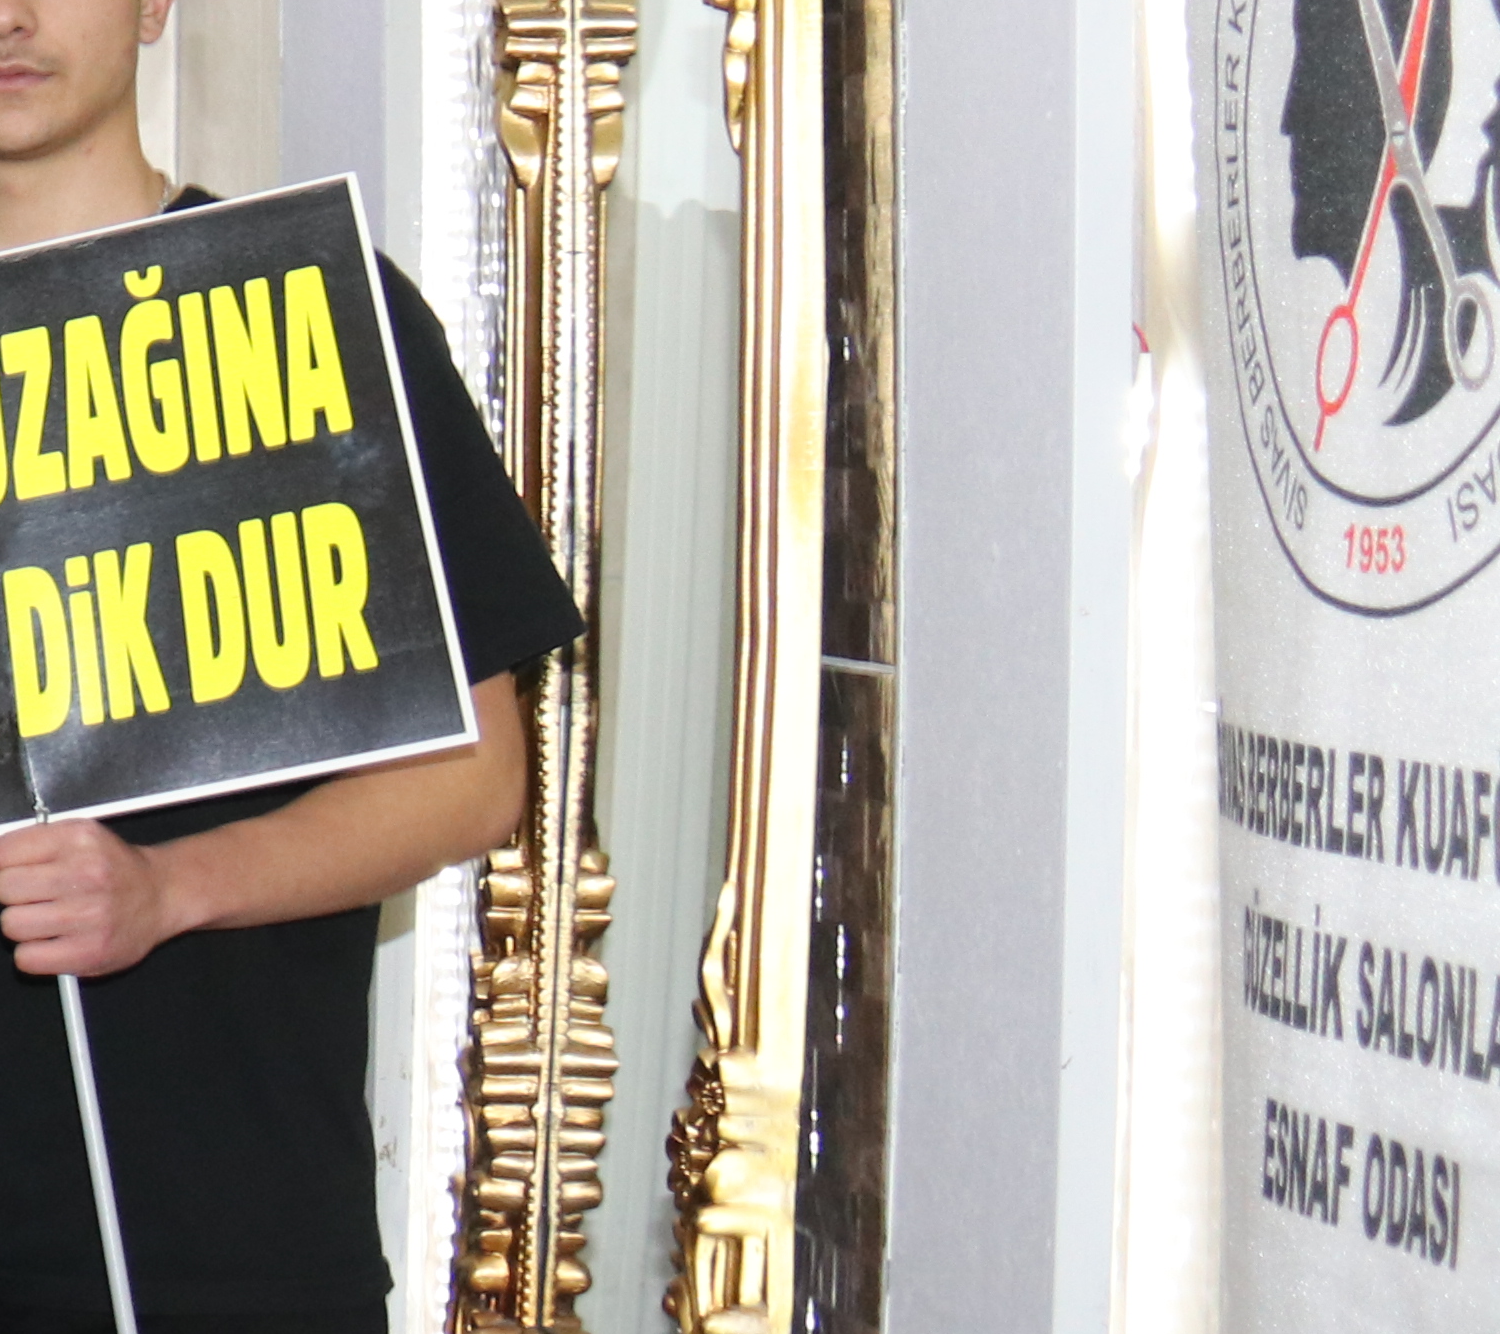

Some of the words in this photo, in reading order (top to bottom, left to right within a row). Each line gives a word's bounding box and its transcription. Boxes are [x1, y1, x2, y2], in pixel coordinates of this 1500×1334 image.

[1224, 53, 1265, 404] BERBERLER
[0, 540, 169, 740] DİK
[176, 501, 379, 710] DUR
[1343, 522, 1407, 575] 1953
[1395, 757, 1500, 889] KUAF
[1262, 1096, 1354, 1228] ESNAF
[1362, 1132, 1460, 1272] ODASI
